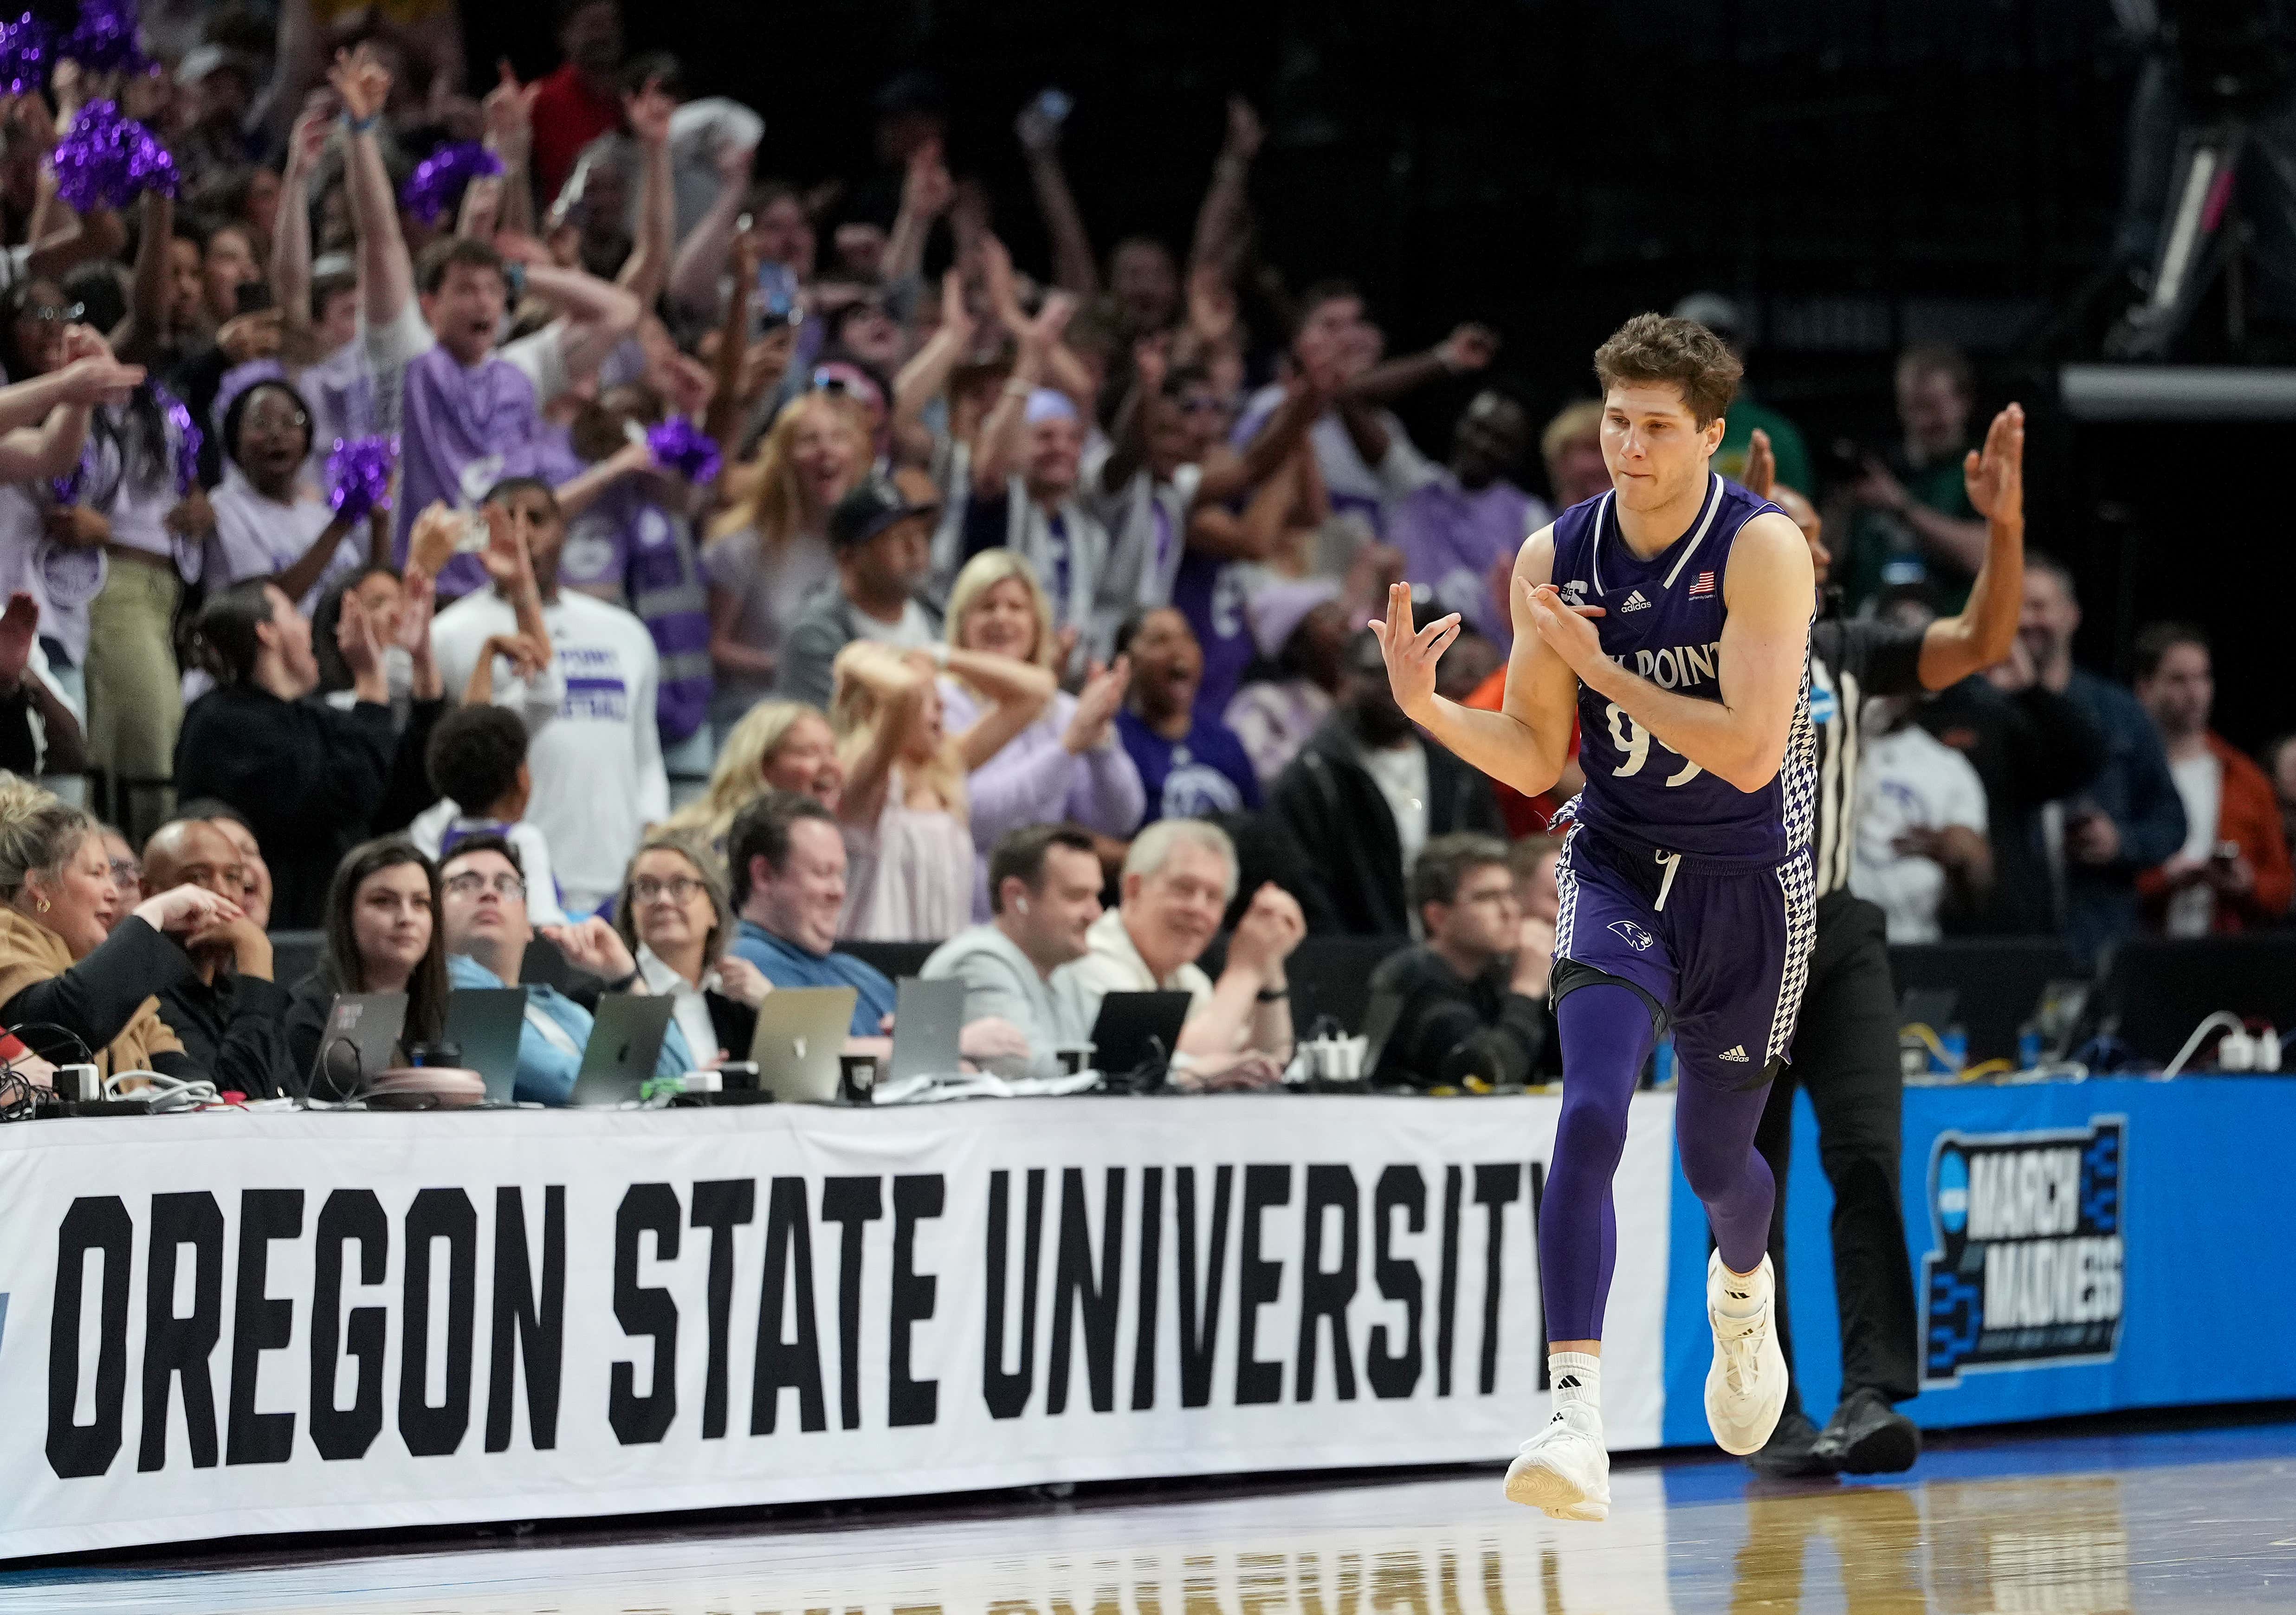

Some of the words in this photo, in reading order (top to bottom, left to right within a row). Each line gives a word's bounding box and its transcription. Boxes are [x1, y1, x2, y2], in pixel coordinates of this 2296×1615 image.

[1621, 601, 1651, 613] adidas
[1719, 1054, 1749, 1062] adidas
[1966, 1146, 2082, 1241] MARCH
[45, 1185, 566, 1479] OREGON
[608, 1173, 945, 1446] STATE
[1984, 1235, 2123, 1330] MADNESS
